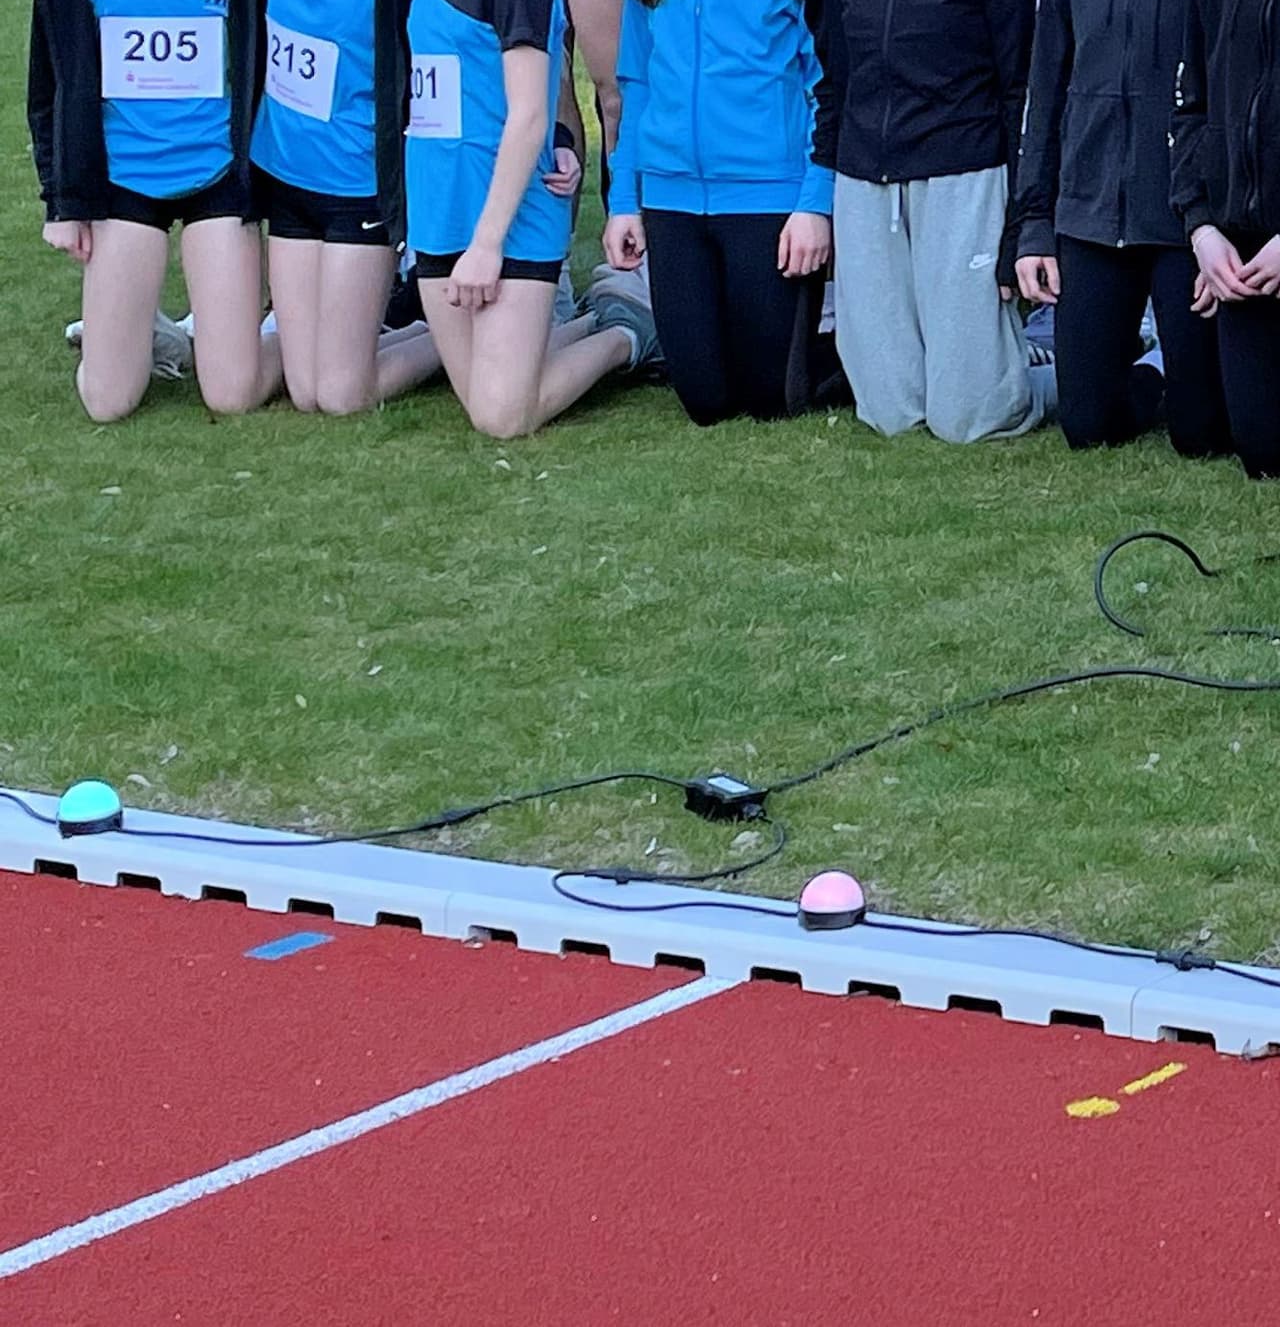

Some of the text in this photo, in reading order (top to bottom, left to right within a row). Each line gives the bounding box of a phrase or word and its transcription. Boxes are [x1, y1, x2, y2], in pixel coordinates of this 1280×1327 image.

[123, 30, 199, 62] 205
[271, 33, 316, 80] 213
[410, 67, 437, 100] 01
